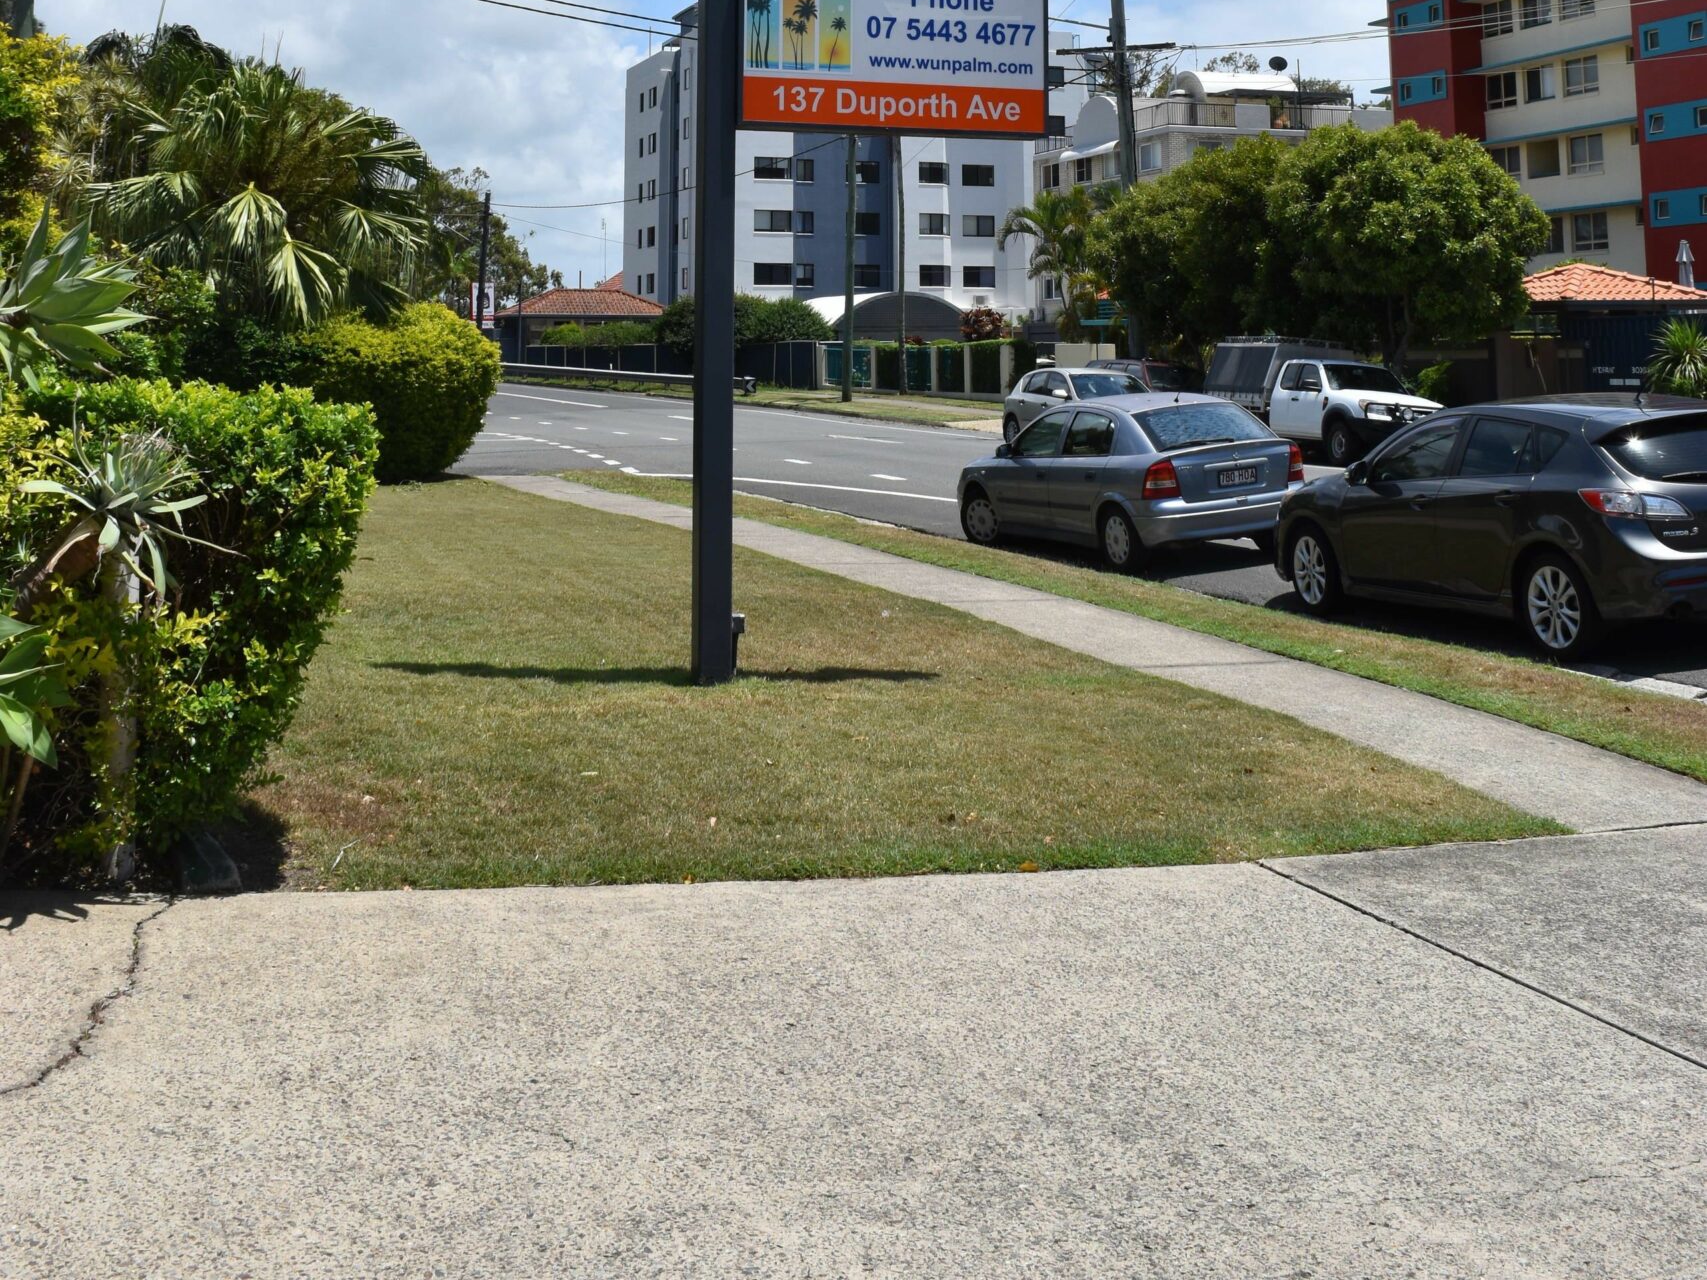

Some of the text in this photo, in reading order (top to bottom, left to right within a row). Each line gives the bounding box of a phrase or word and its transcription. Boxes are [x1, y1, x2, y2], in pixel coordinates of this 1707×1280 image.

[866, 16, 1036, 46] 07 5443 4677
[869, 55, 1034, 75] www.wunpalm.com
[773, 85, 1021, 121] 137 Duporth Ave
